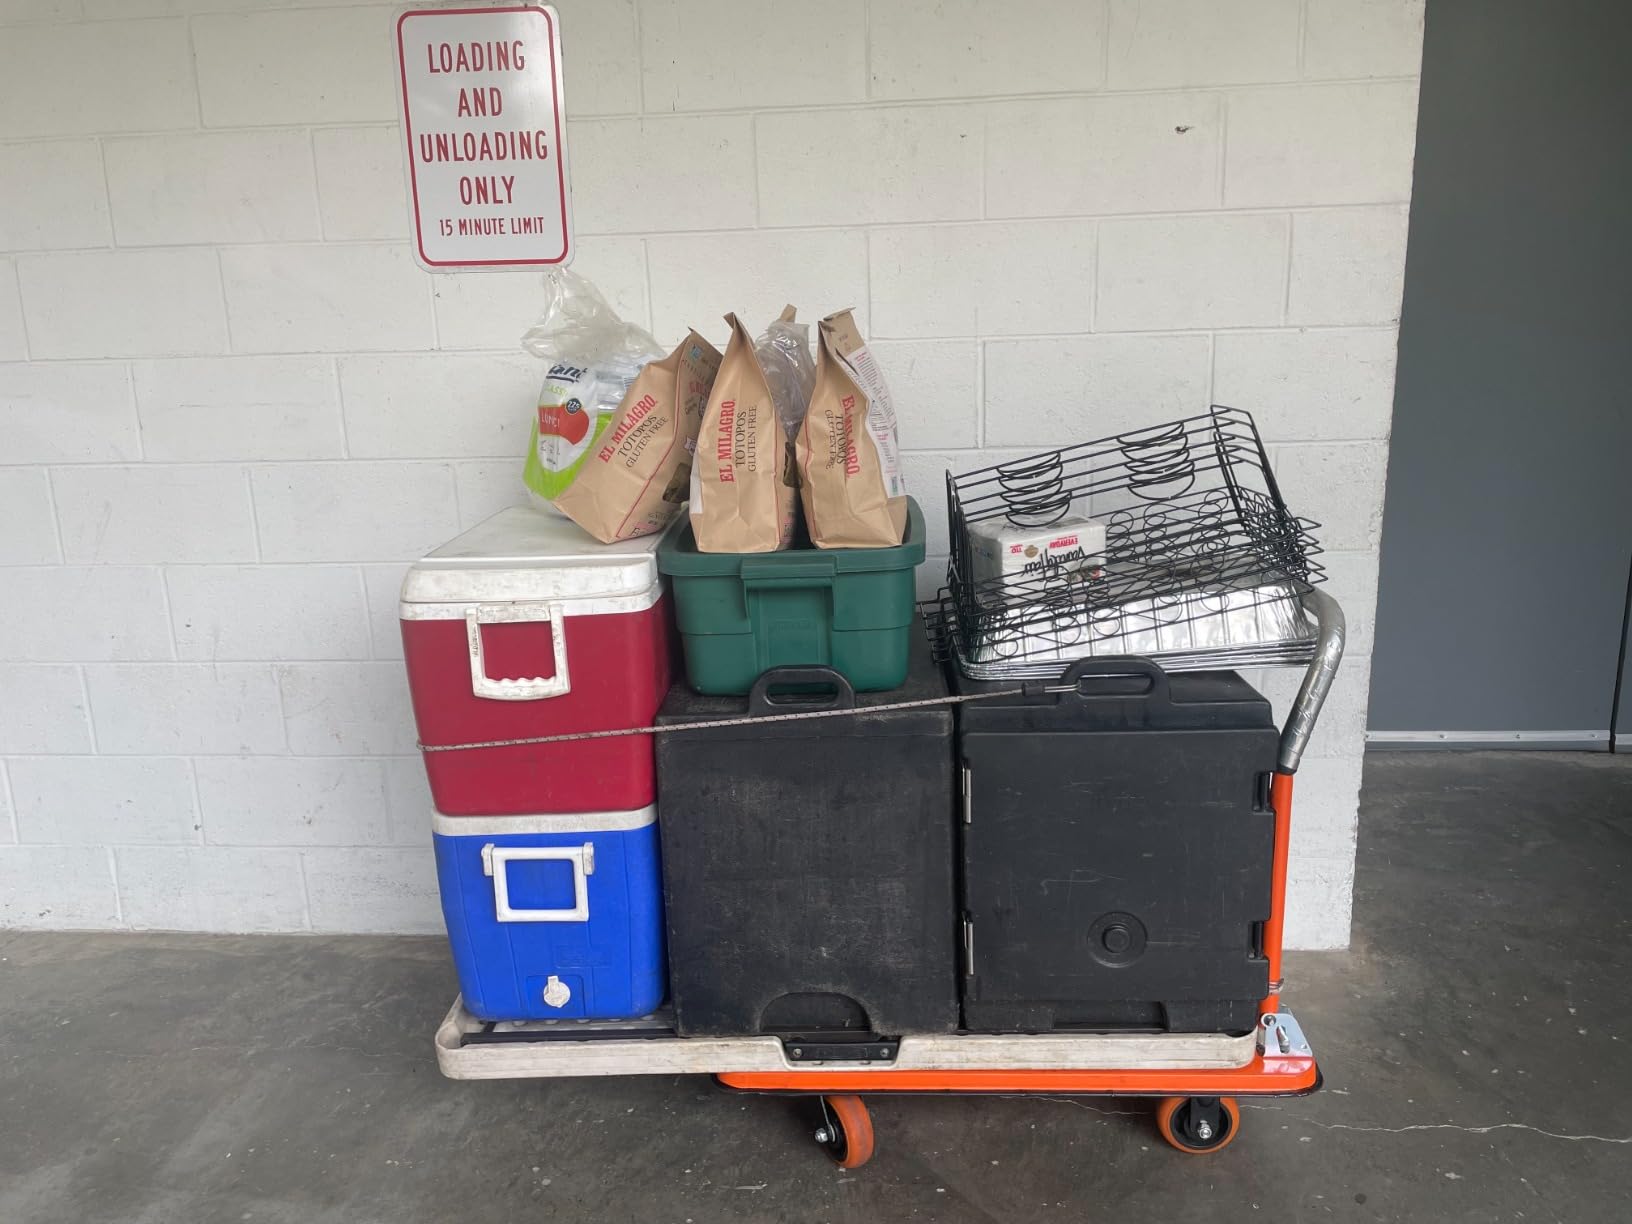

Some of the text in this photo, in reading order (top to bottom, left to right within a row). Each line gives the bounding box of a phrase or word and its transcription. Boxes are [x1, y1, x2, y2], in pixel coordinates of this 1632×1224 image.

[427, 40, 525, 73] LOADING
[458, 87, 502, 118] AND
[419, 130, 548, 163] UNLOADING
[459, 175, 515, 205] ONLY
[439, 216, 544, 236] 15 MINUTE LIMIT
[598, 393, 656, 464] EL MILAGRO
[617, 414, 657, 458] TOTOPOS
[626, 415, 669, 468] GLUTEN FREE
[717, 400, 736, 483] EL MILAGRO
[735, 410, 747, 468] TOTOPOS
[748, 406, 758, 472] GLUTEN FREE
[842, 395, 861, 475] EL MILAGRO
[1049, 537, 1078, 549] EVERYDAY
